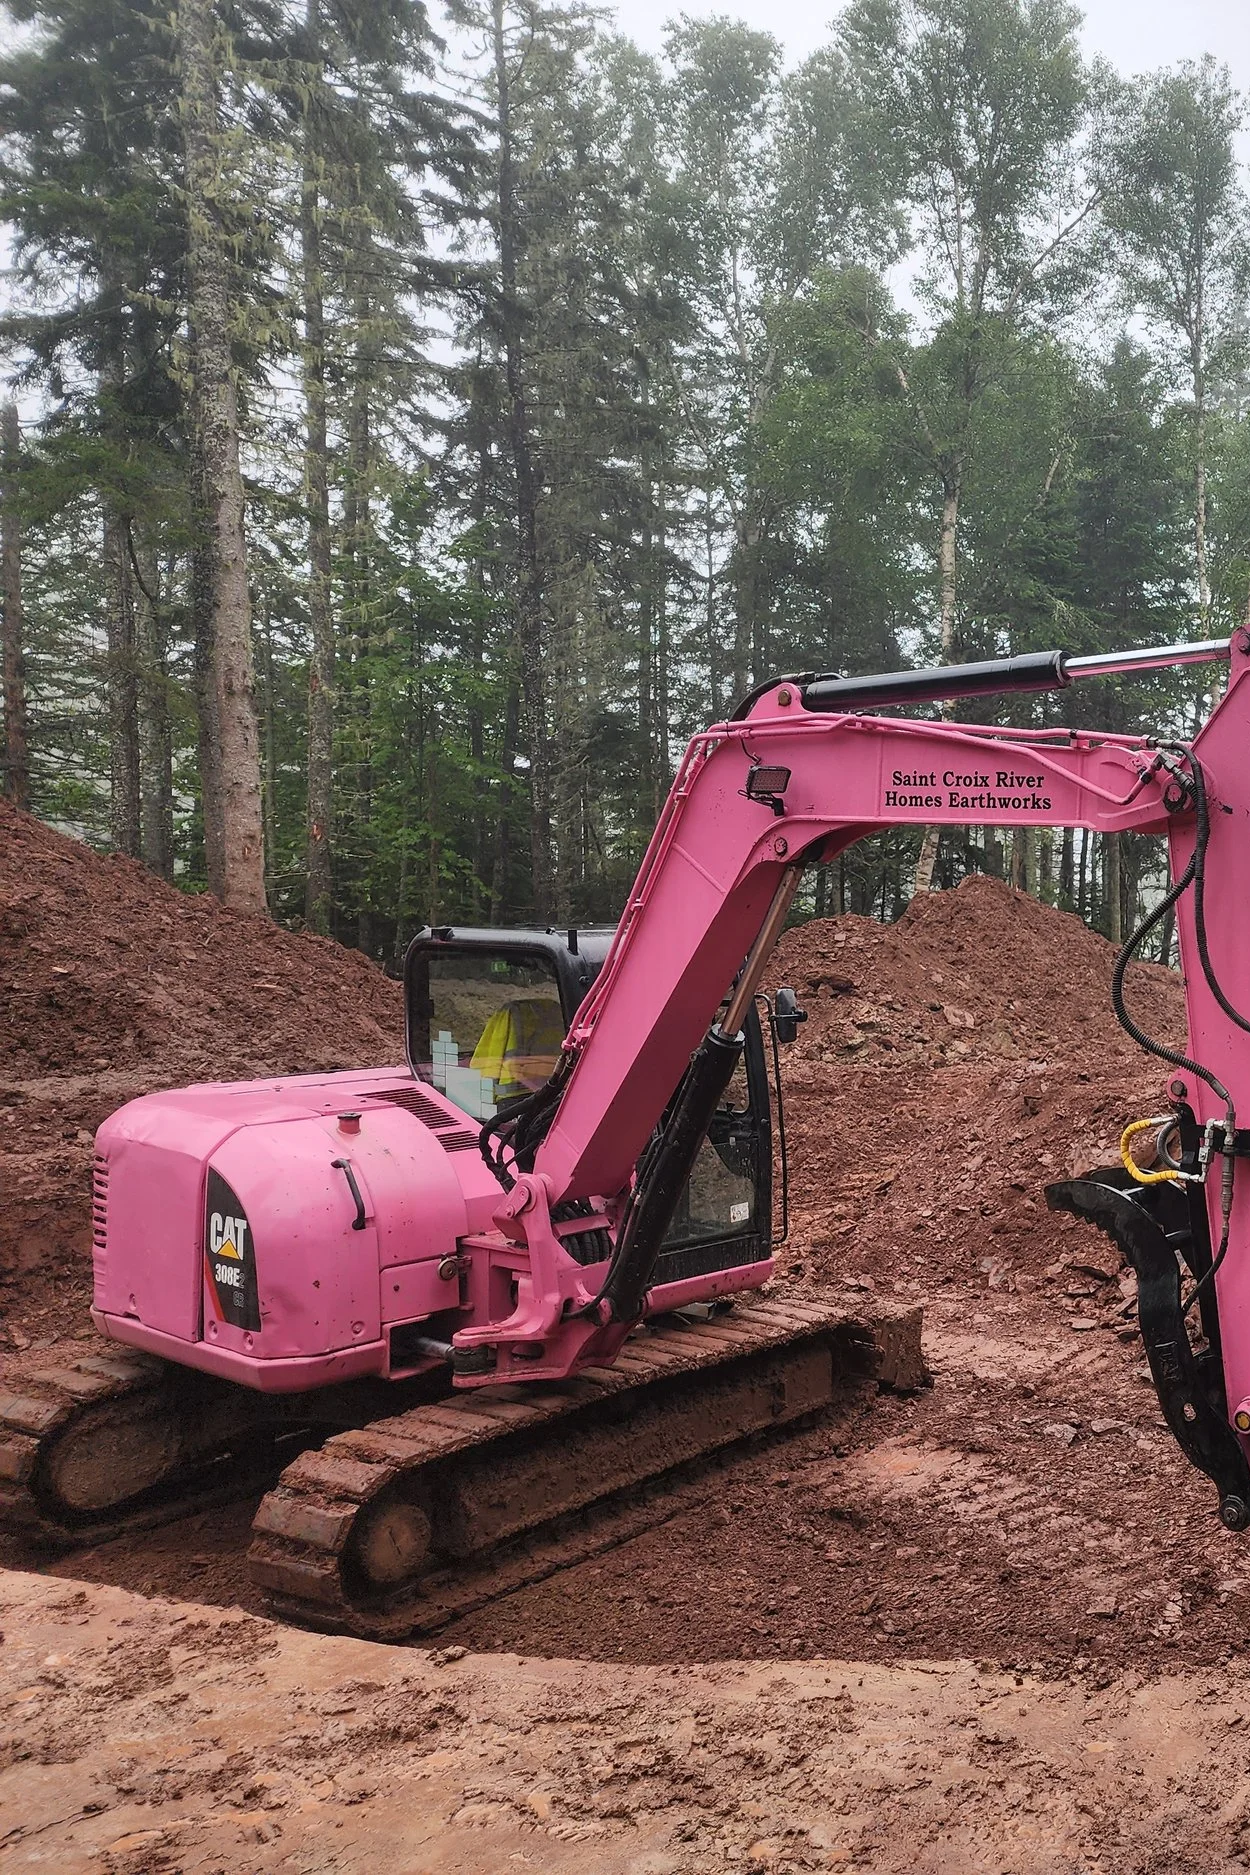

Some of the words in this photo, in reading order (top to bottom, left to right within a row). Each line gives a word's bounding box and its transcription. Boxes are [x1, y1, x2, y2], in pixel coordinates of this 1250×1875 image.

[892, 771, 936, 787] Saint
[942, 771, 990, 788] Croix
[995, 771, 1045, 788] River
[885, 791, 942, 807] Homes
[948, 792, 1052, 810] Earthworks
[210, 1212, 247, 1261] CAT
